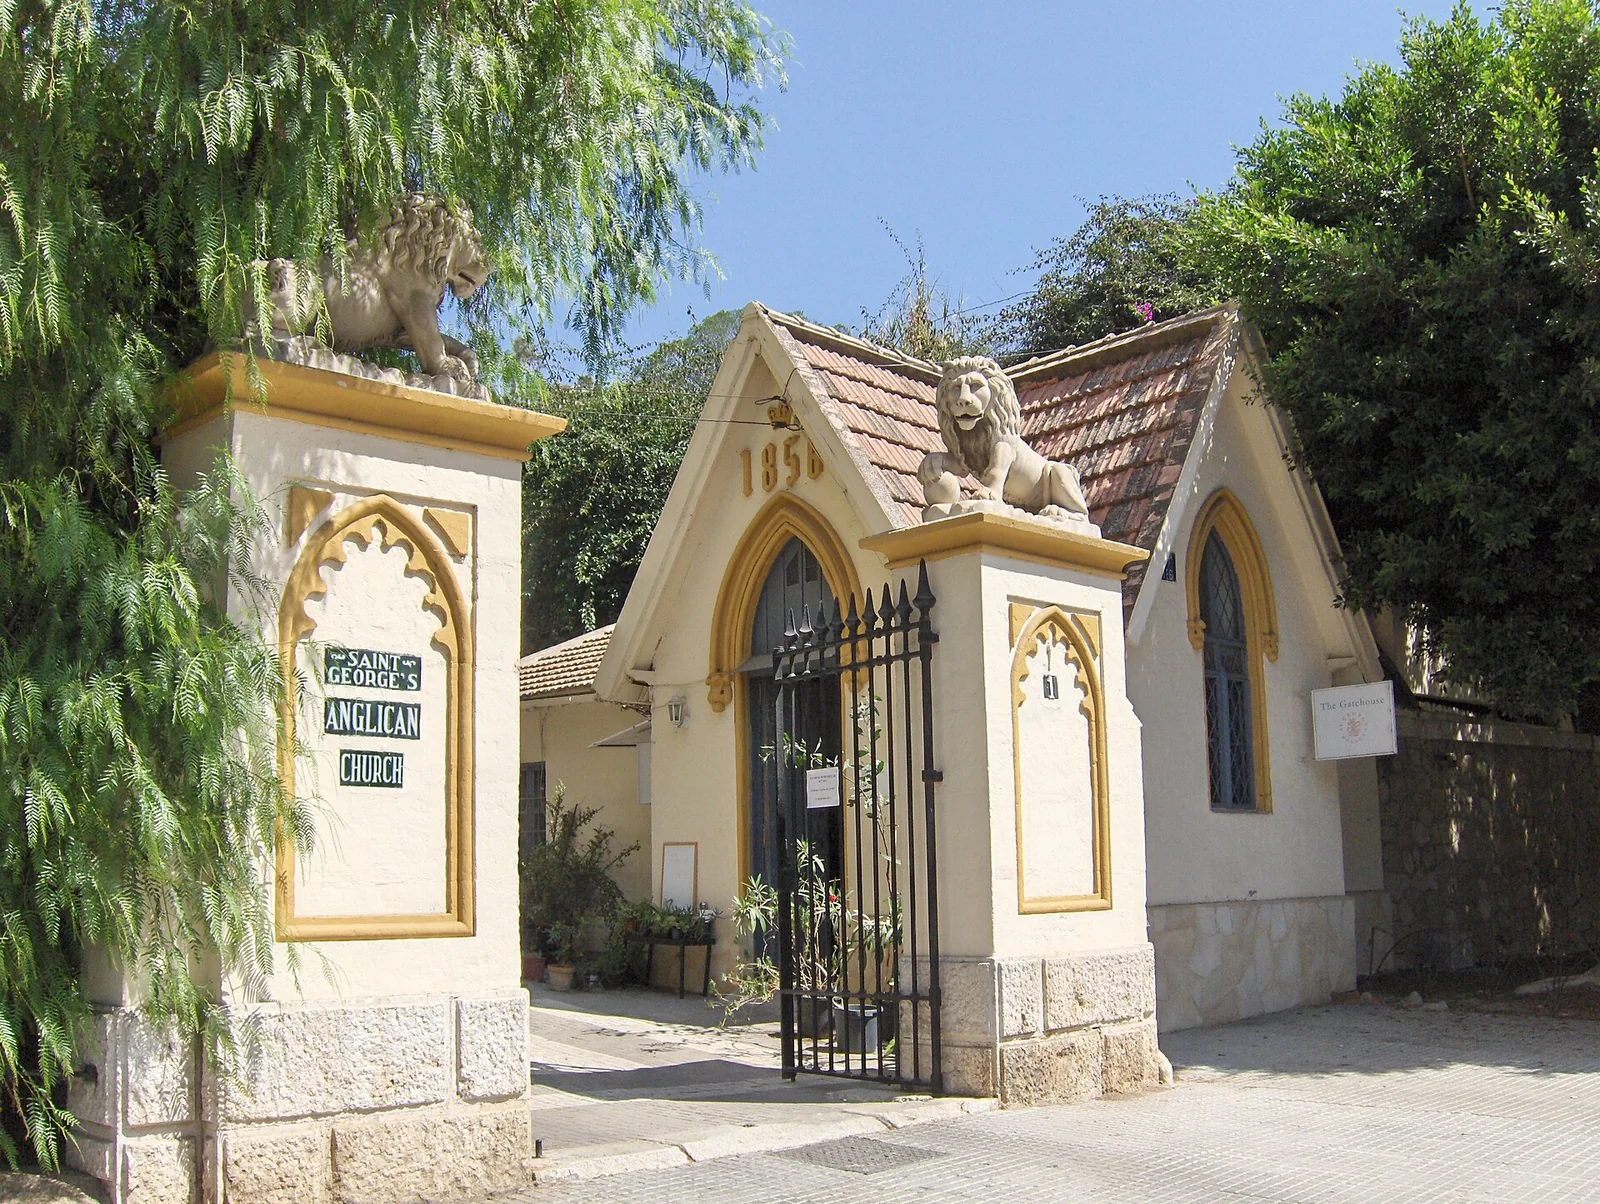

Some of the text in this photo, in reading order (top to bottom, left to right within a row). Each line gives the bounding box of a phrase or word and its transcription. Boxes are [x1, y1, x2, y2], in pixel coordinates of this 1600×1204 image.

[347, 651, 400, 672] SAINT
[328, 666, 418, 690] GEORGE'S
[1320, 697, 1385, 711] The Gatehouse
[325, 700, 418, 737] ANGLICAN
[340, 753, 403, 784] CHURCH
